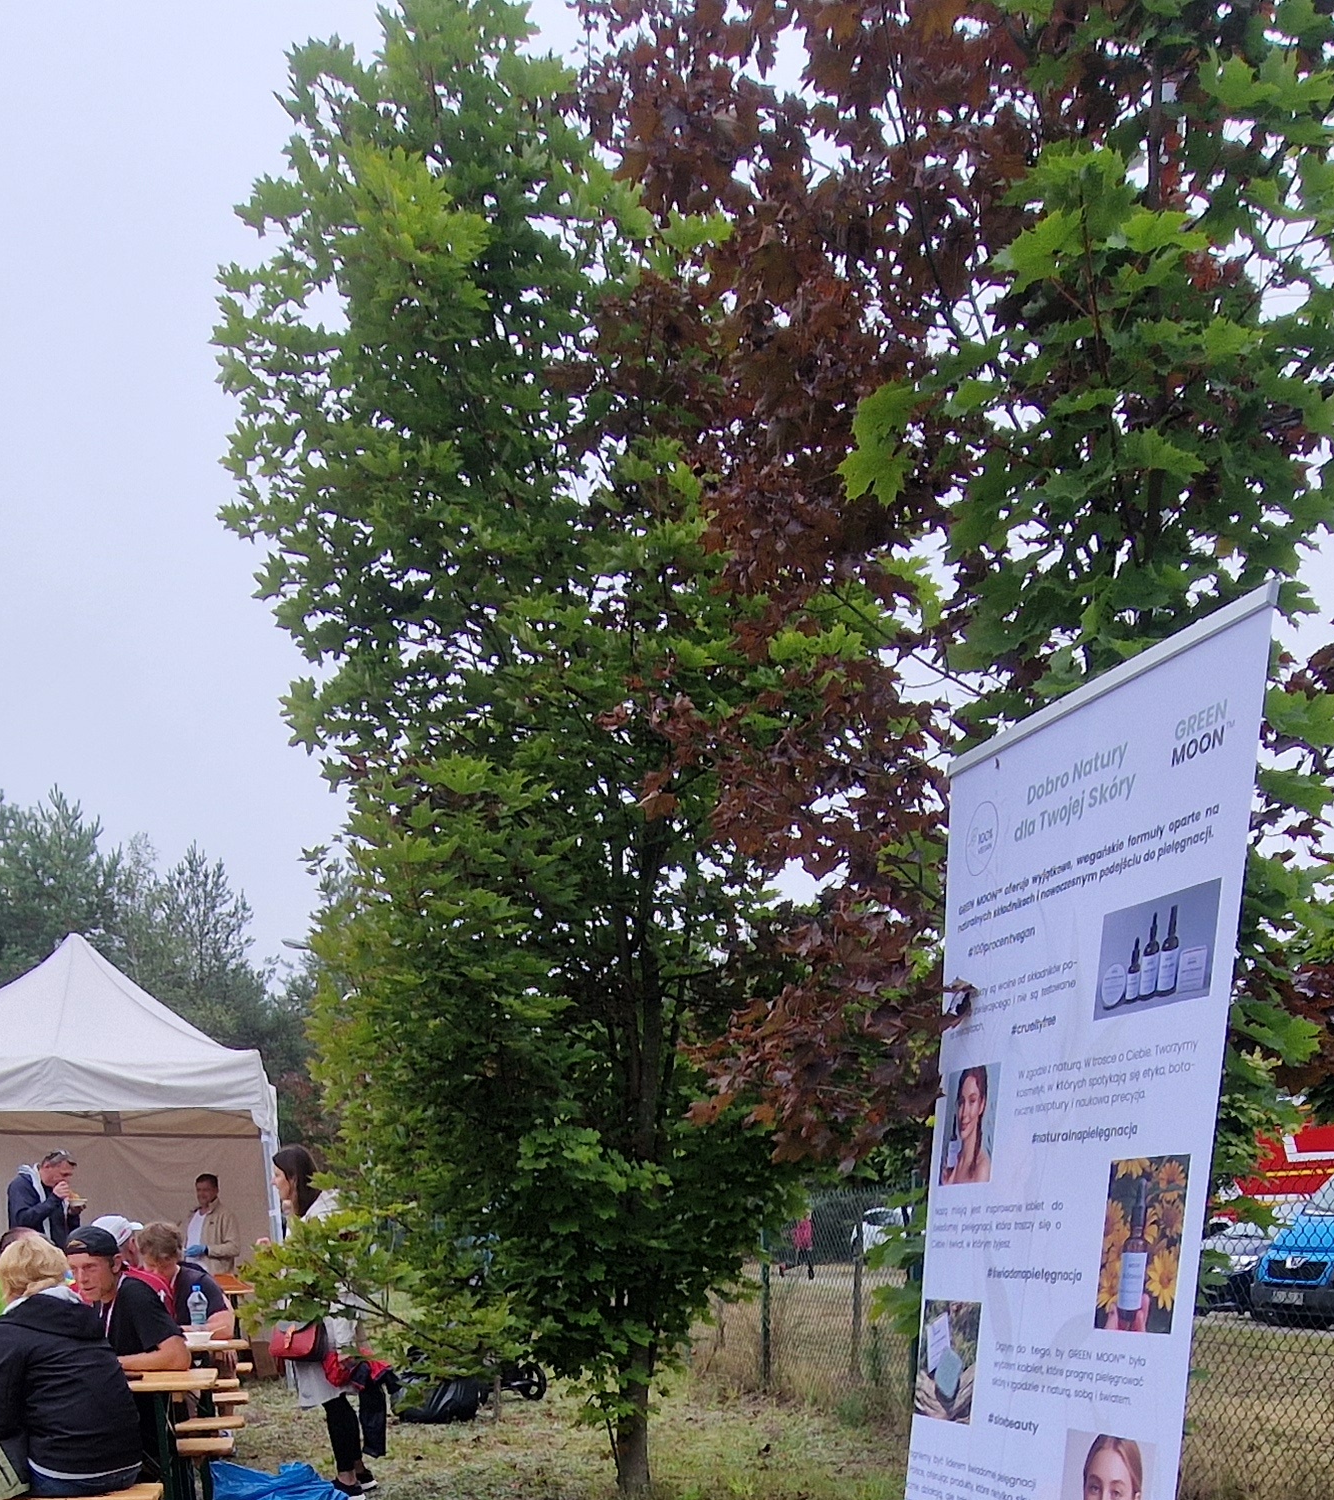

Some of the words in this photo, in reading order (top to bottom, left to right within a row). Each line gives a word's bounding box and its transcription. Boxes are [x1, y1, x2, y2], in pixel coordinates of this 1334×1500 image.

[1175, 699, 1226, 740] GREEN
[1027, 772, 1068, 804] Dobro
[1072, 743, 1127, 781] Natury
[1014, 819, 1035, 841] dla
[1040, 790, 1084, 829] Twojej
[1088, 774, 1135, 807] Skóry
[1168, 811, 1200, 833] oparte
[1205, 804, 1219, 817] na
[1143, 849, 1155, 861] do
[1051, 1200, 1063, 1210] do
[1055, 1221, 1061, 1229] o
[988, 1413, 1038, 1434] #slobeauty
